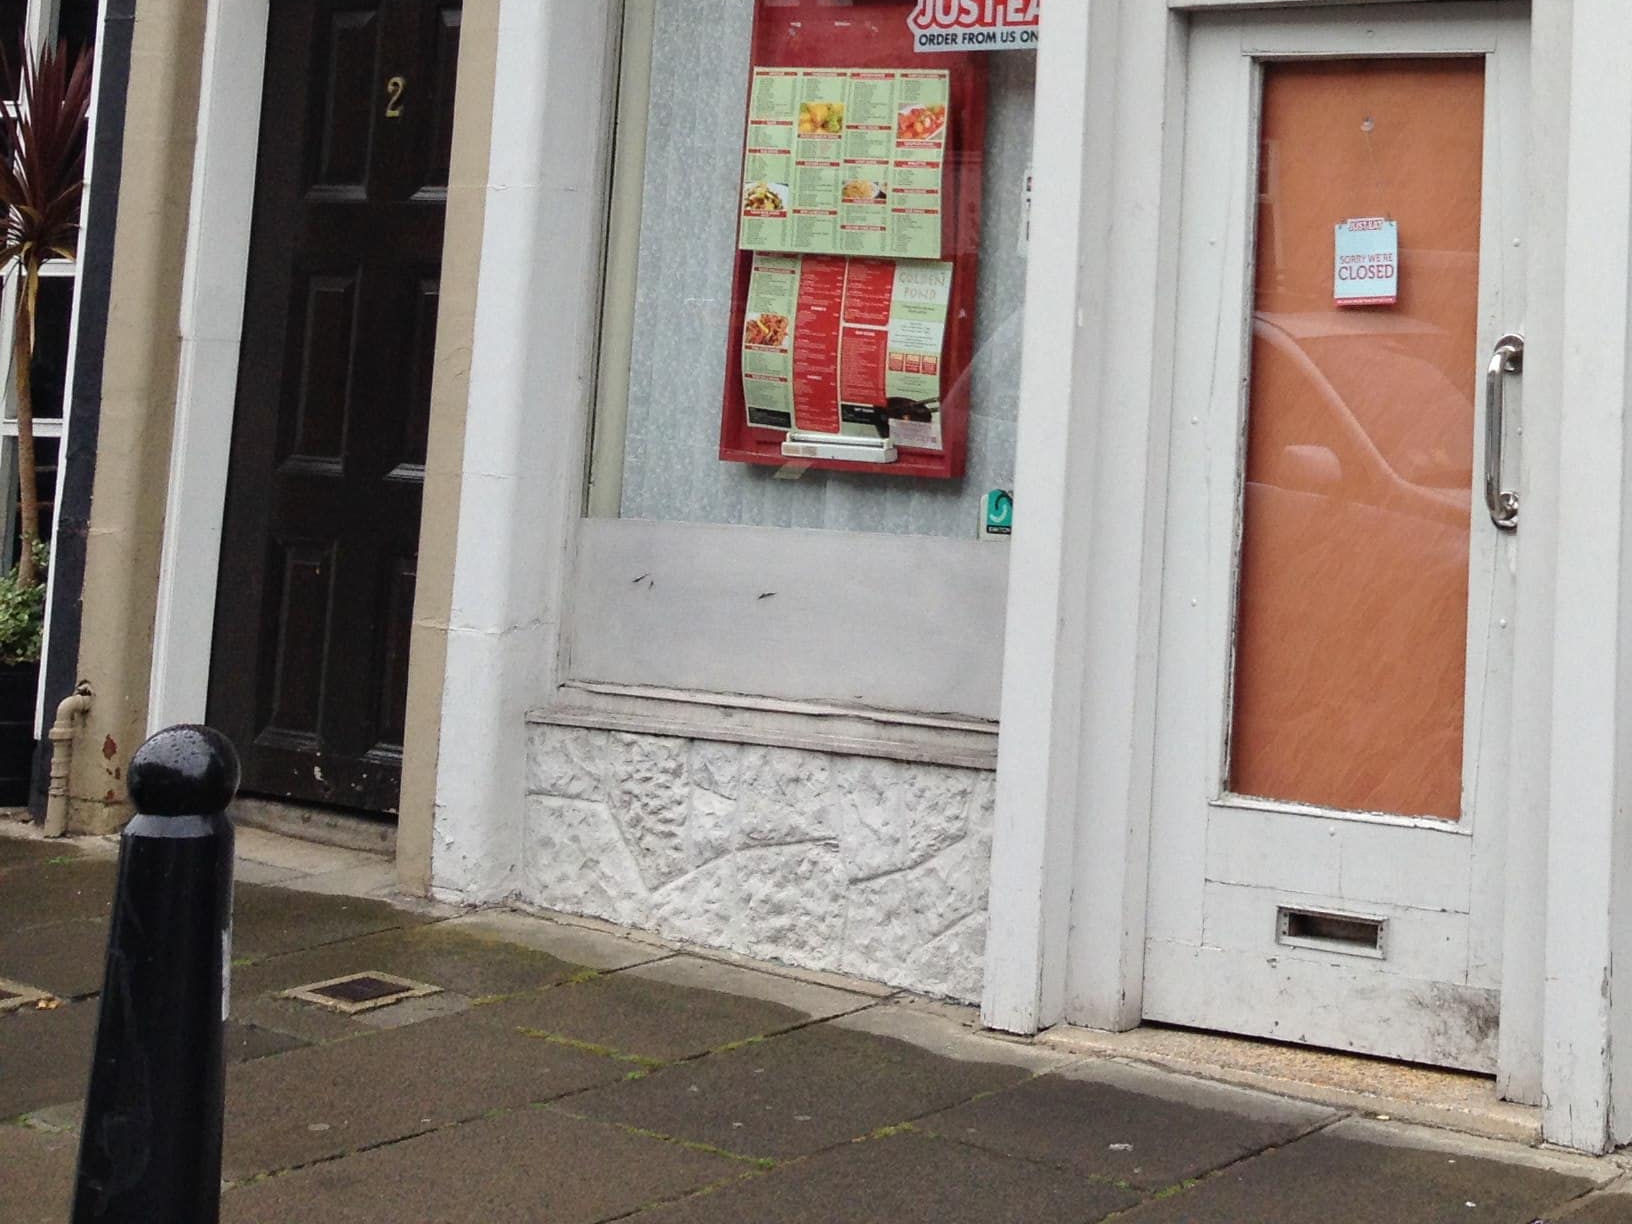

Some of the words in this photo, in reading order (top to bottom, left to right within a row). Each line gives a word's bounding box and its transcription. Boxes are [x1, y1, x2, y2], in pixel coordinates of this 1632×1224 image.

[918, 33, 958, 46] ORDER
[961, 31, 996, 45] FROM
[1001, 31, 1016, 43] US
[385, 76, 405, 117] 2
[1338, 264, 1394, 281] CLOSED
